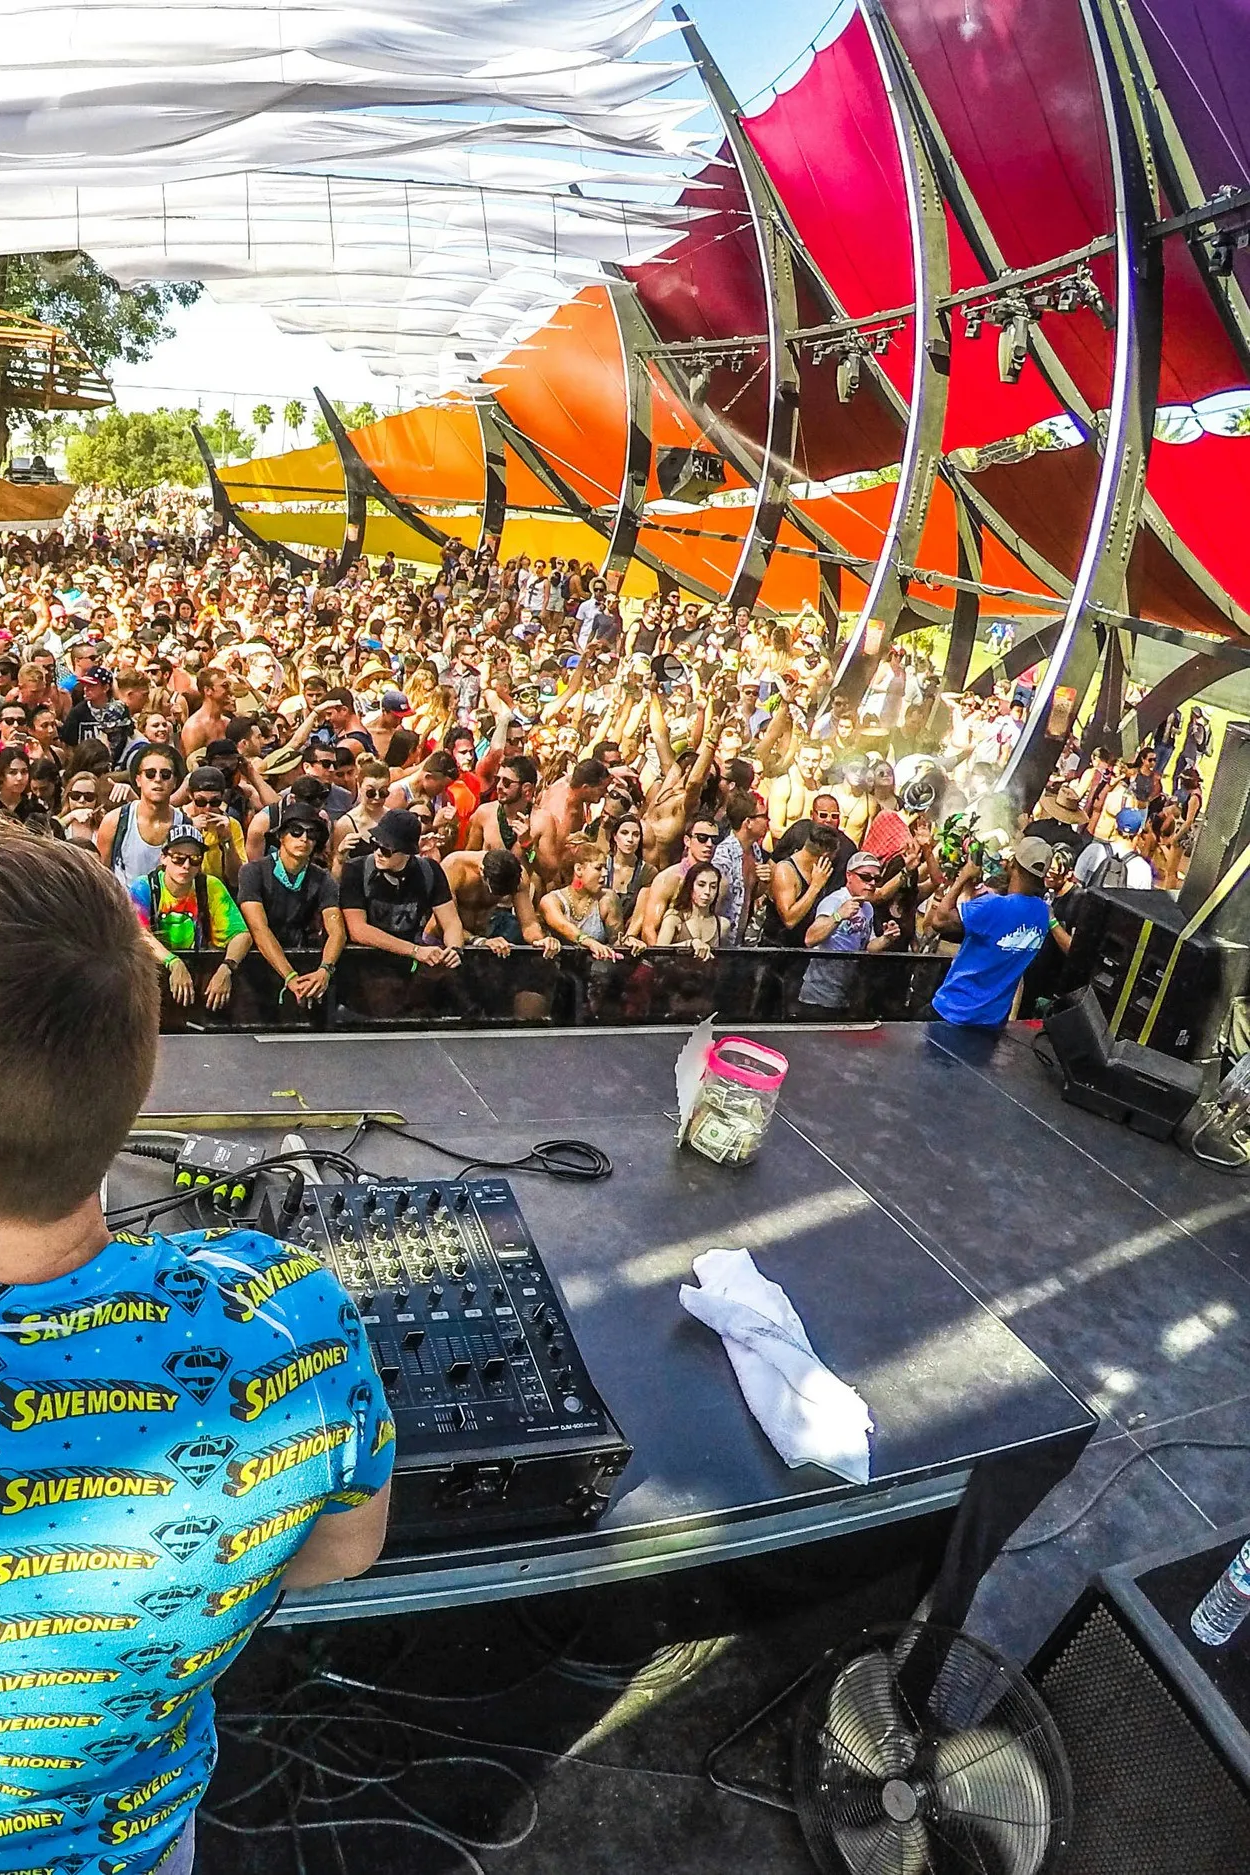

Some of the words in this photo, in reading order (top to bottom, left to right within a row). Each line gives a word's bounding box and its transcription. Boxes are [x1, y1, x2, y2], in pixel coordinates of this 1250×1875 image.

[19, 1302, 170, 1345] SAVEMONEY
[246, 1346, 349, 1421] SAVEMONEY
[11, 1390, 179, 1431] SAVEMONEY
[235, 1425, 355, 1498] SAVEMONEY
[1, 1477, 177, 1515] SAVEMONEY
